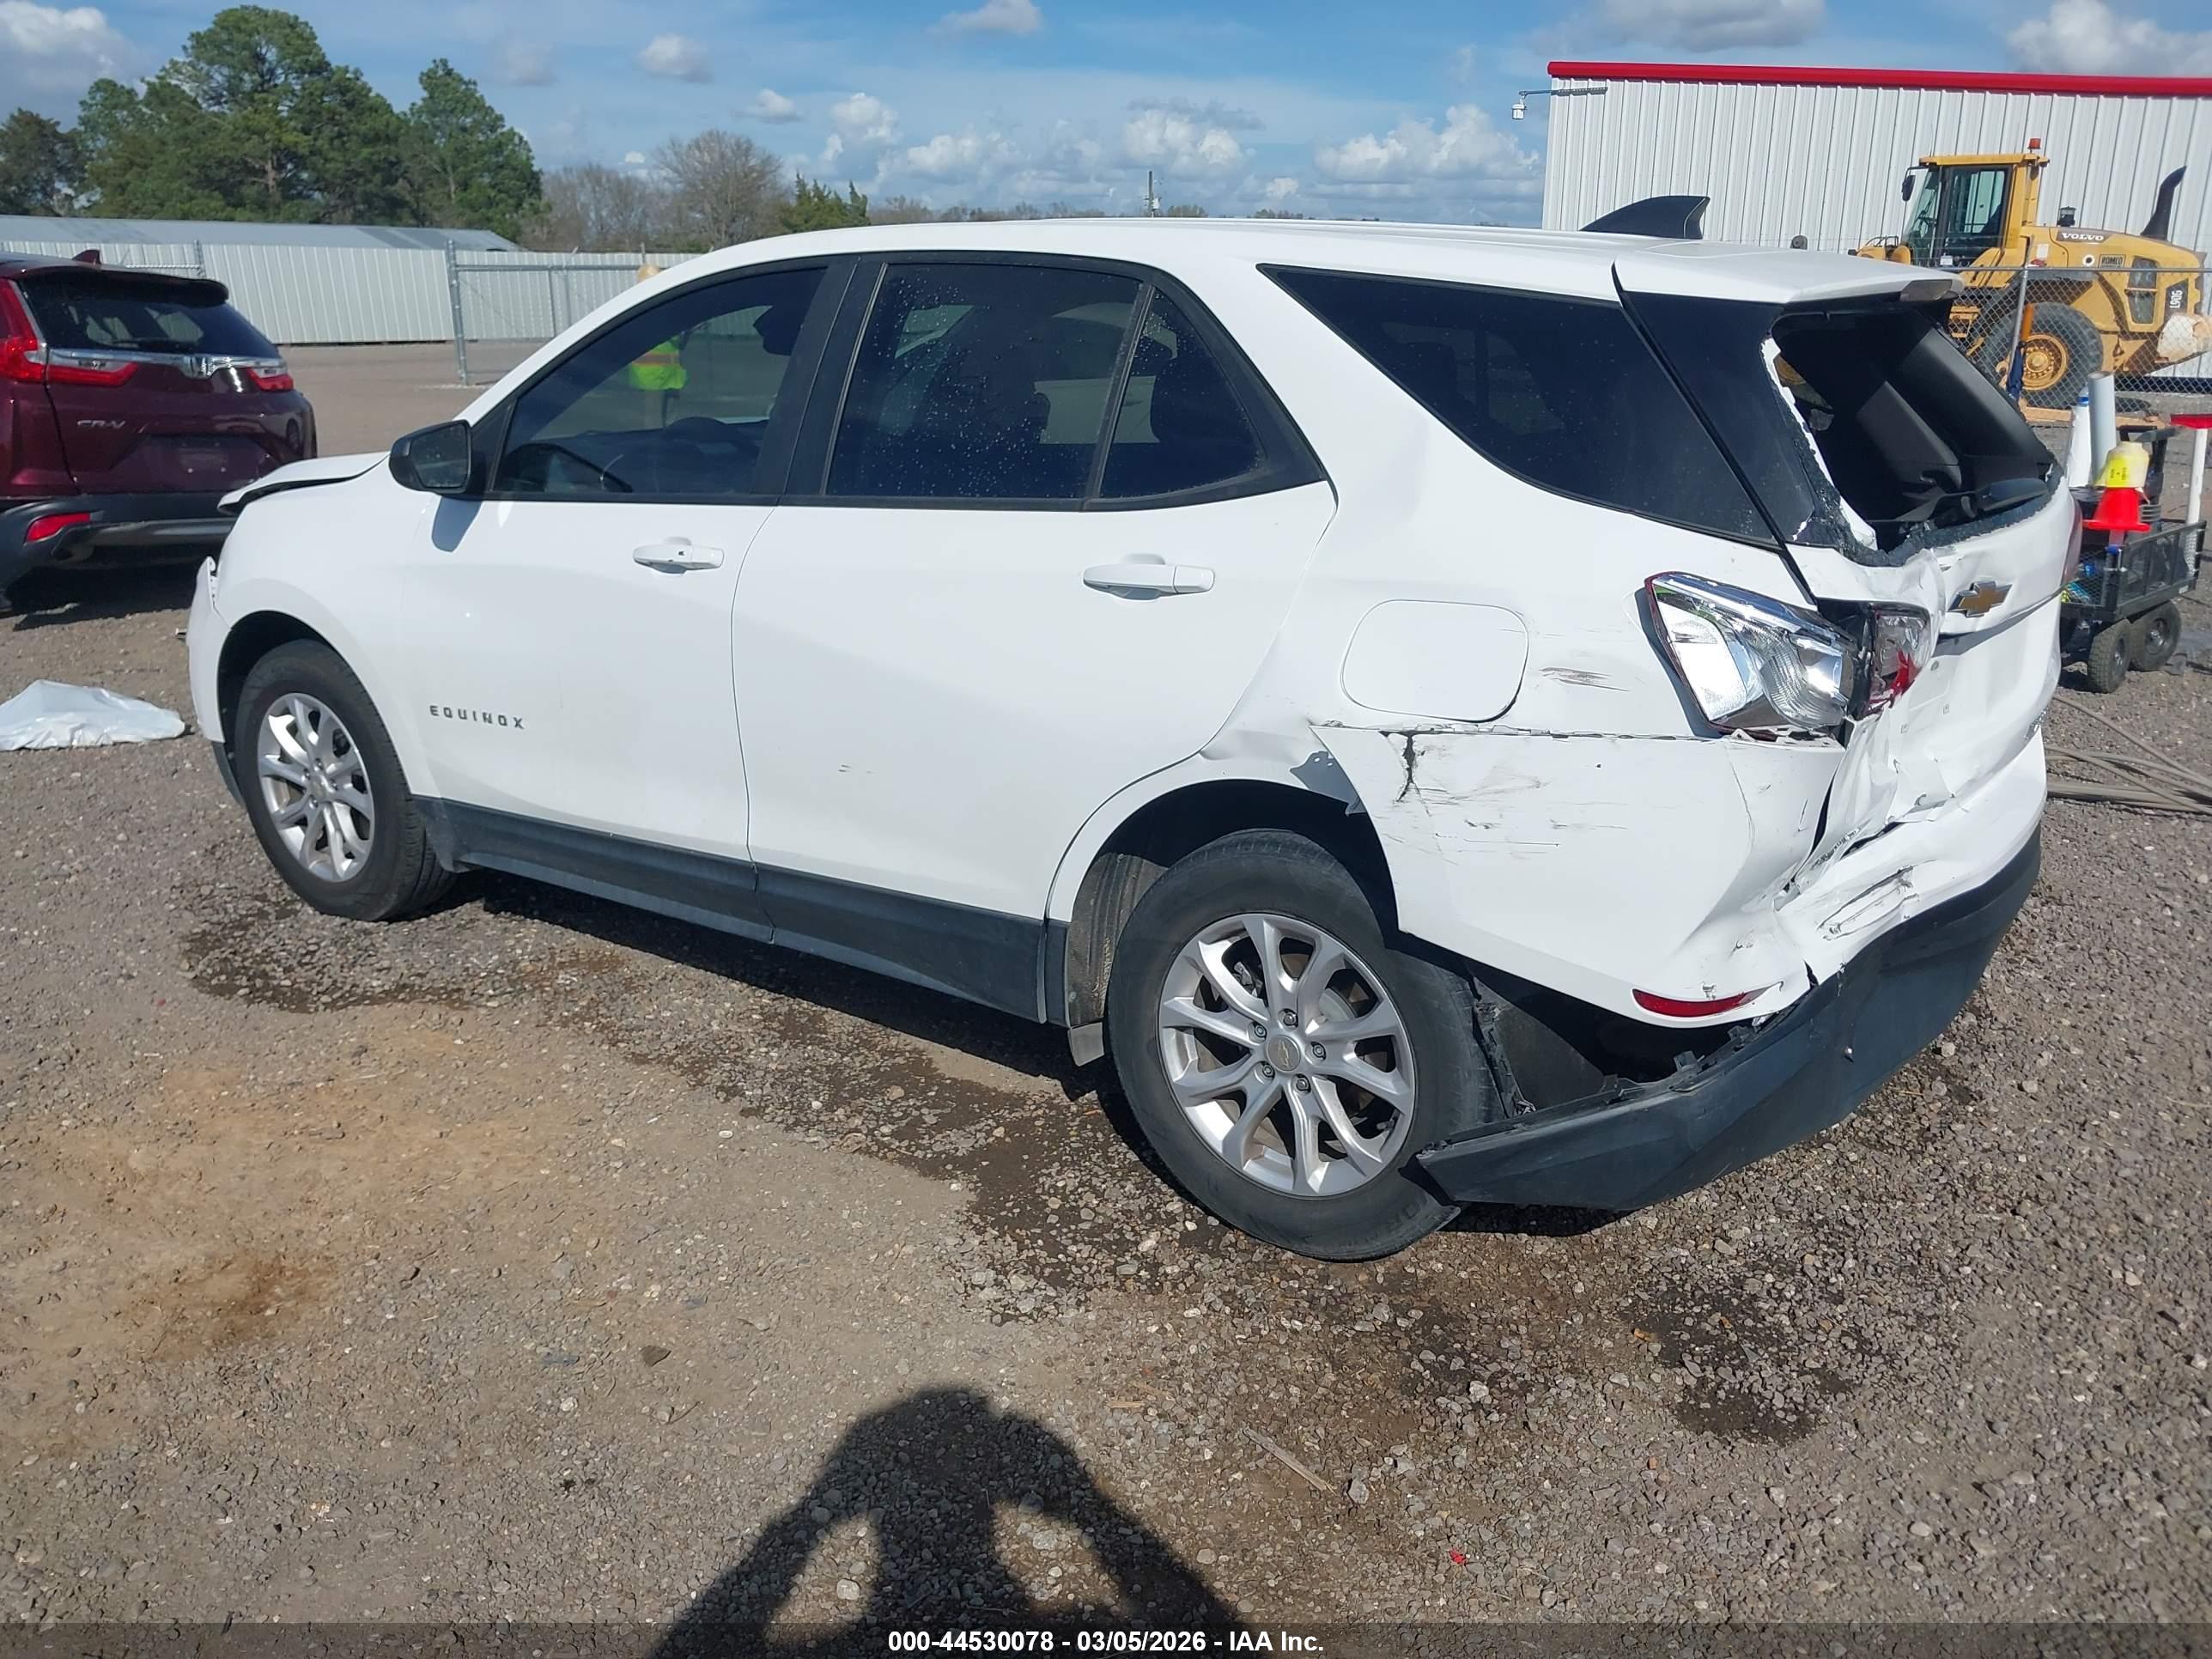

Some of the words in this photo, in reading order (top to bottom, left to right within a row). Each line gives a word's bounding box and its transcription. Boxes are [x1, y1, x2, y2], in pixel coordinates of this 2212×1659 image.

[2062, 233, 2104, 241] VOLVO
[2169, 289, 2183, 309] L90G
[77, 419, 126, 428] CR-V
[429, 705, 525, 730] EQUINOX
